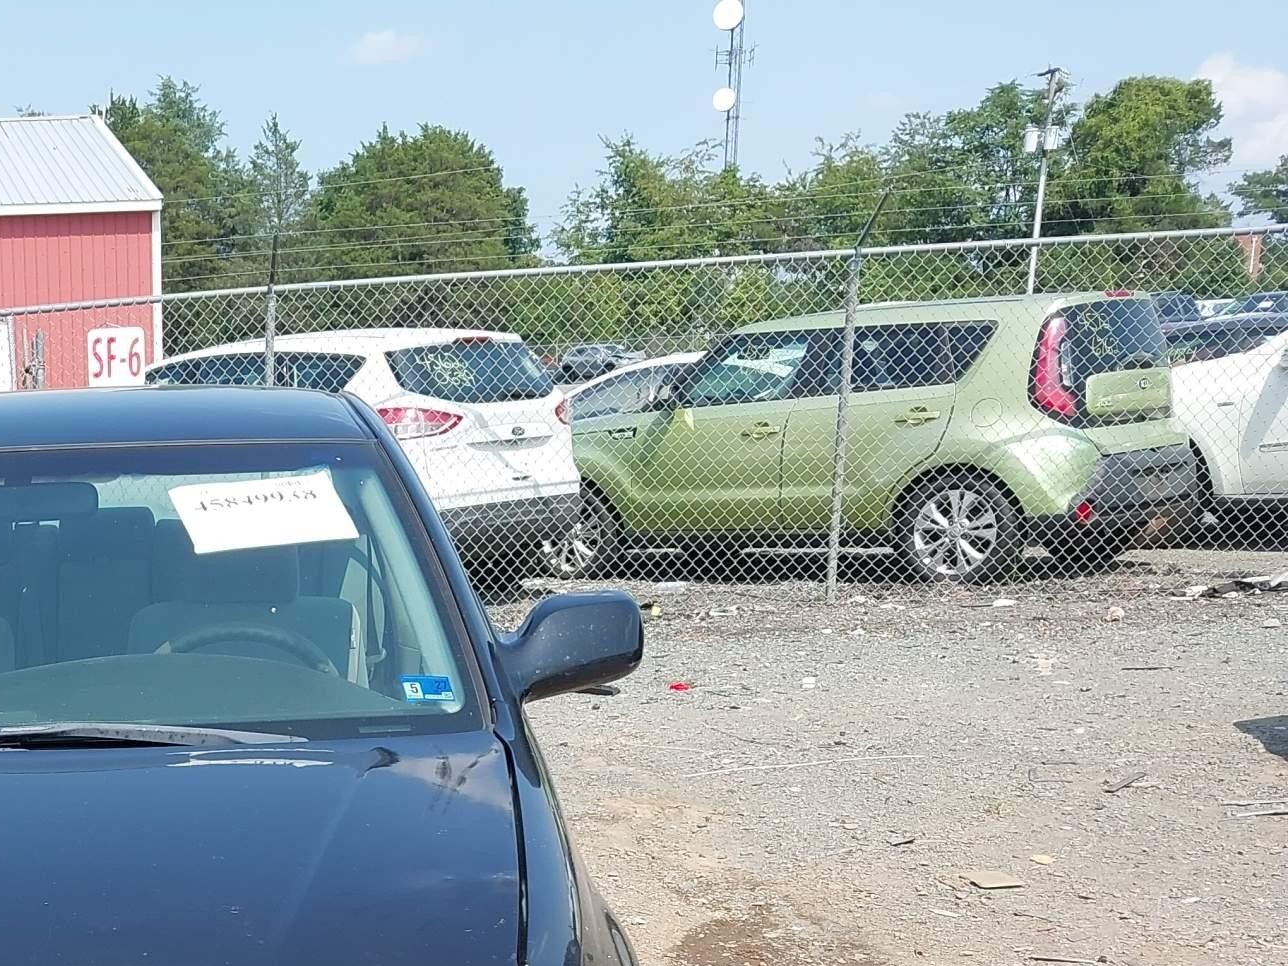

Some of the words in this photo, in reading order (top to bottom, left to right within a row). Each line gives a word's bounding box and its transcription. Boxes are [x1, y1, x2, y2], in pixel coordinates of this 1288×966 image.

[92, 336, 141, 379] SF-6
[409, 683, 419, 694] 5
[434, 680, 447, 690] 27
